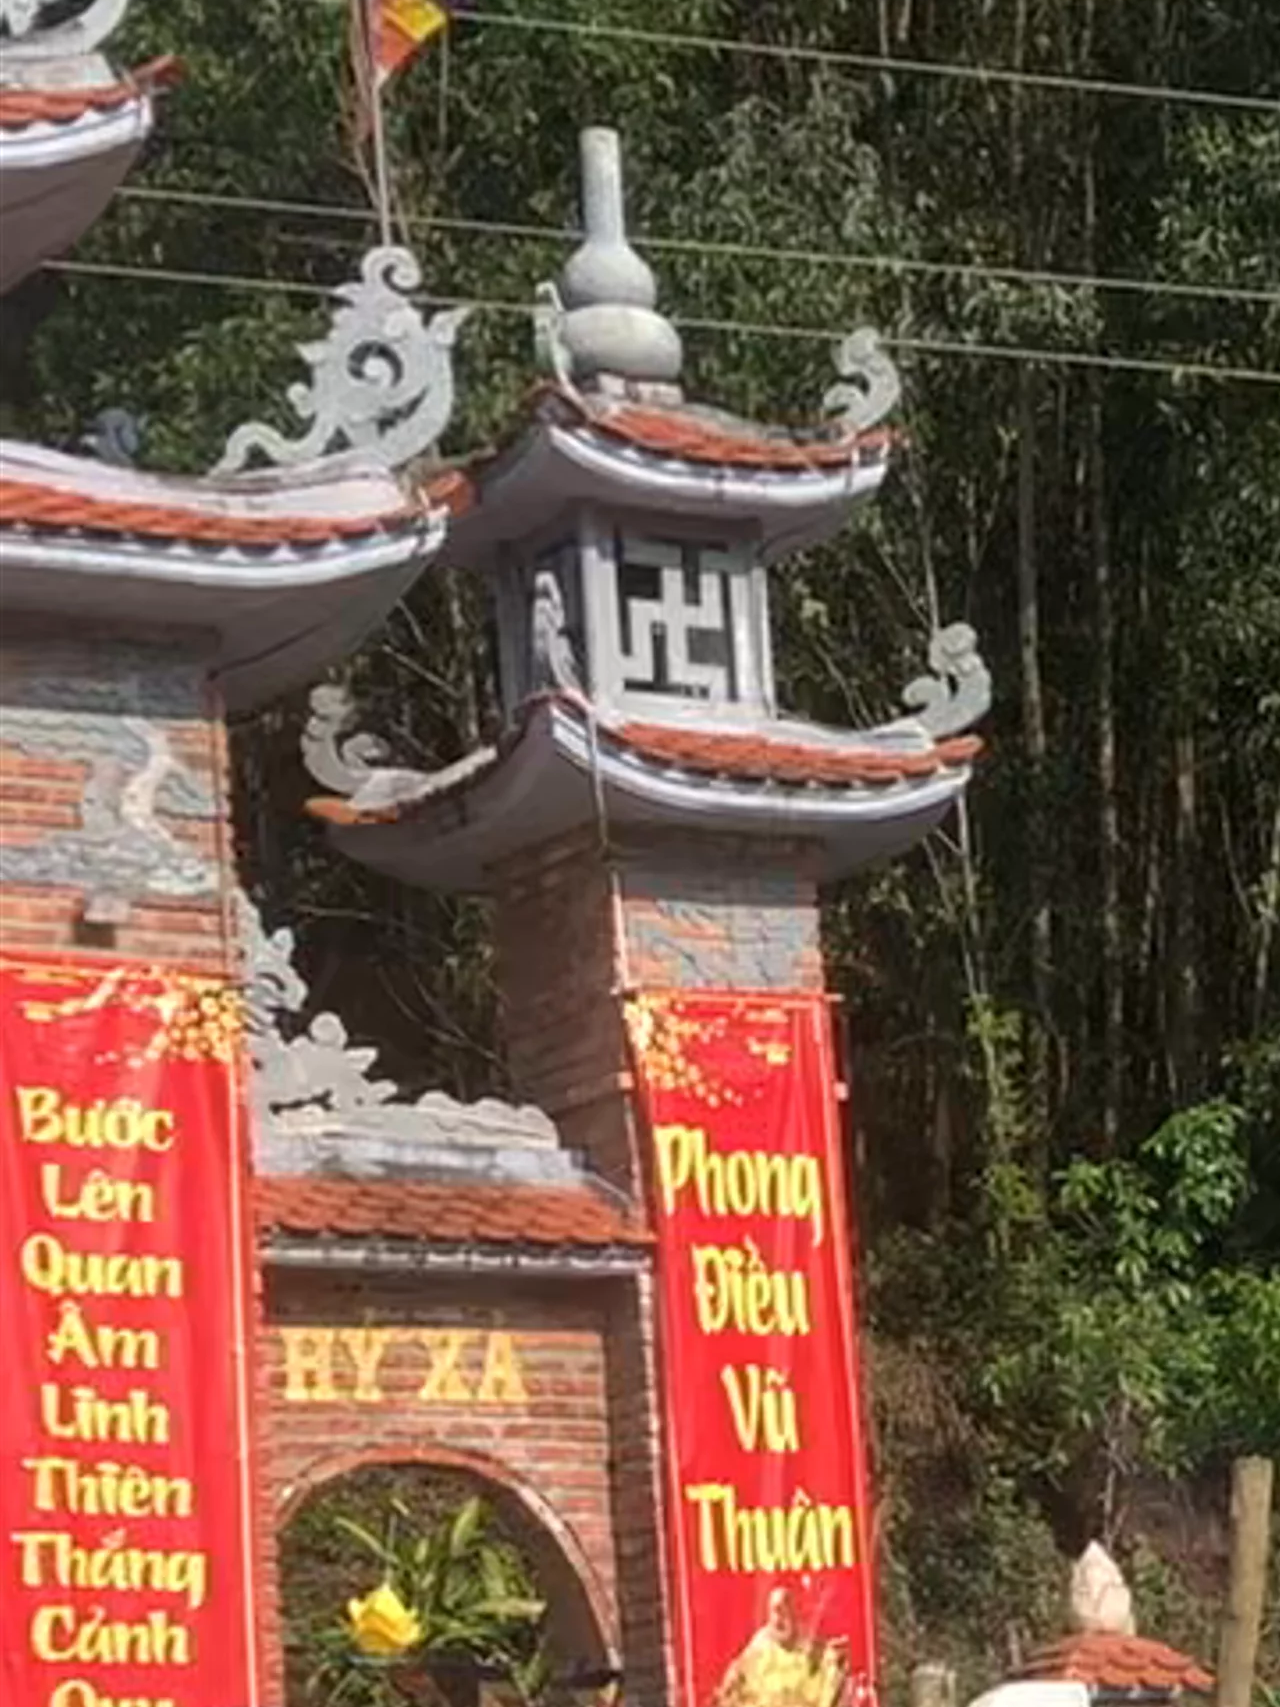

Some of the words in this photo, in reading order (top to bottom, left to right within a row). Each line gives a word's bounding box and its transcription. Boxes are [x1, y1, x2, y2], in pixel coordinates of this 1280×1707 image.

[41, 1162, 154, 1223] Lên
[654, 1125, 821, 1247] Phong
[21, 1233, 183, 1297] Quan
[691, 1234, 811, 1337] Điều
[46, 1298, 159, 1369] Âm
[41, 1382, 170, 1443] Linh
[721, 1364, 799, 1453] Vũ
[21, 1456, 193, 1517] Thiên
[10, 1528, 207, 1610] Thắng
[686, 1484, 854, 1591] Thuận
[31, 1605, 191, 1664] Cảnh
